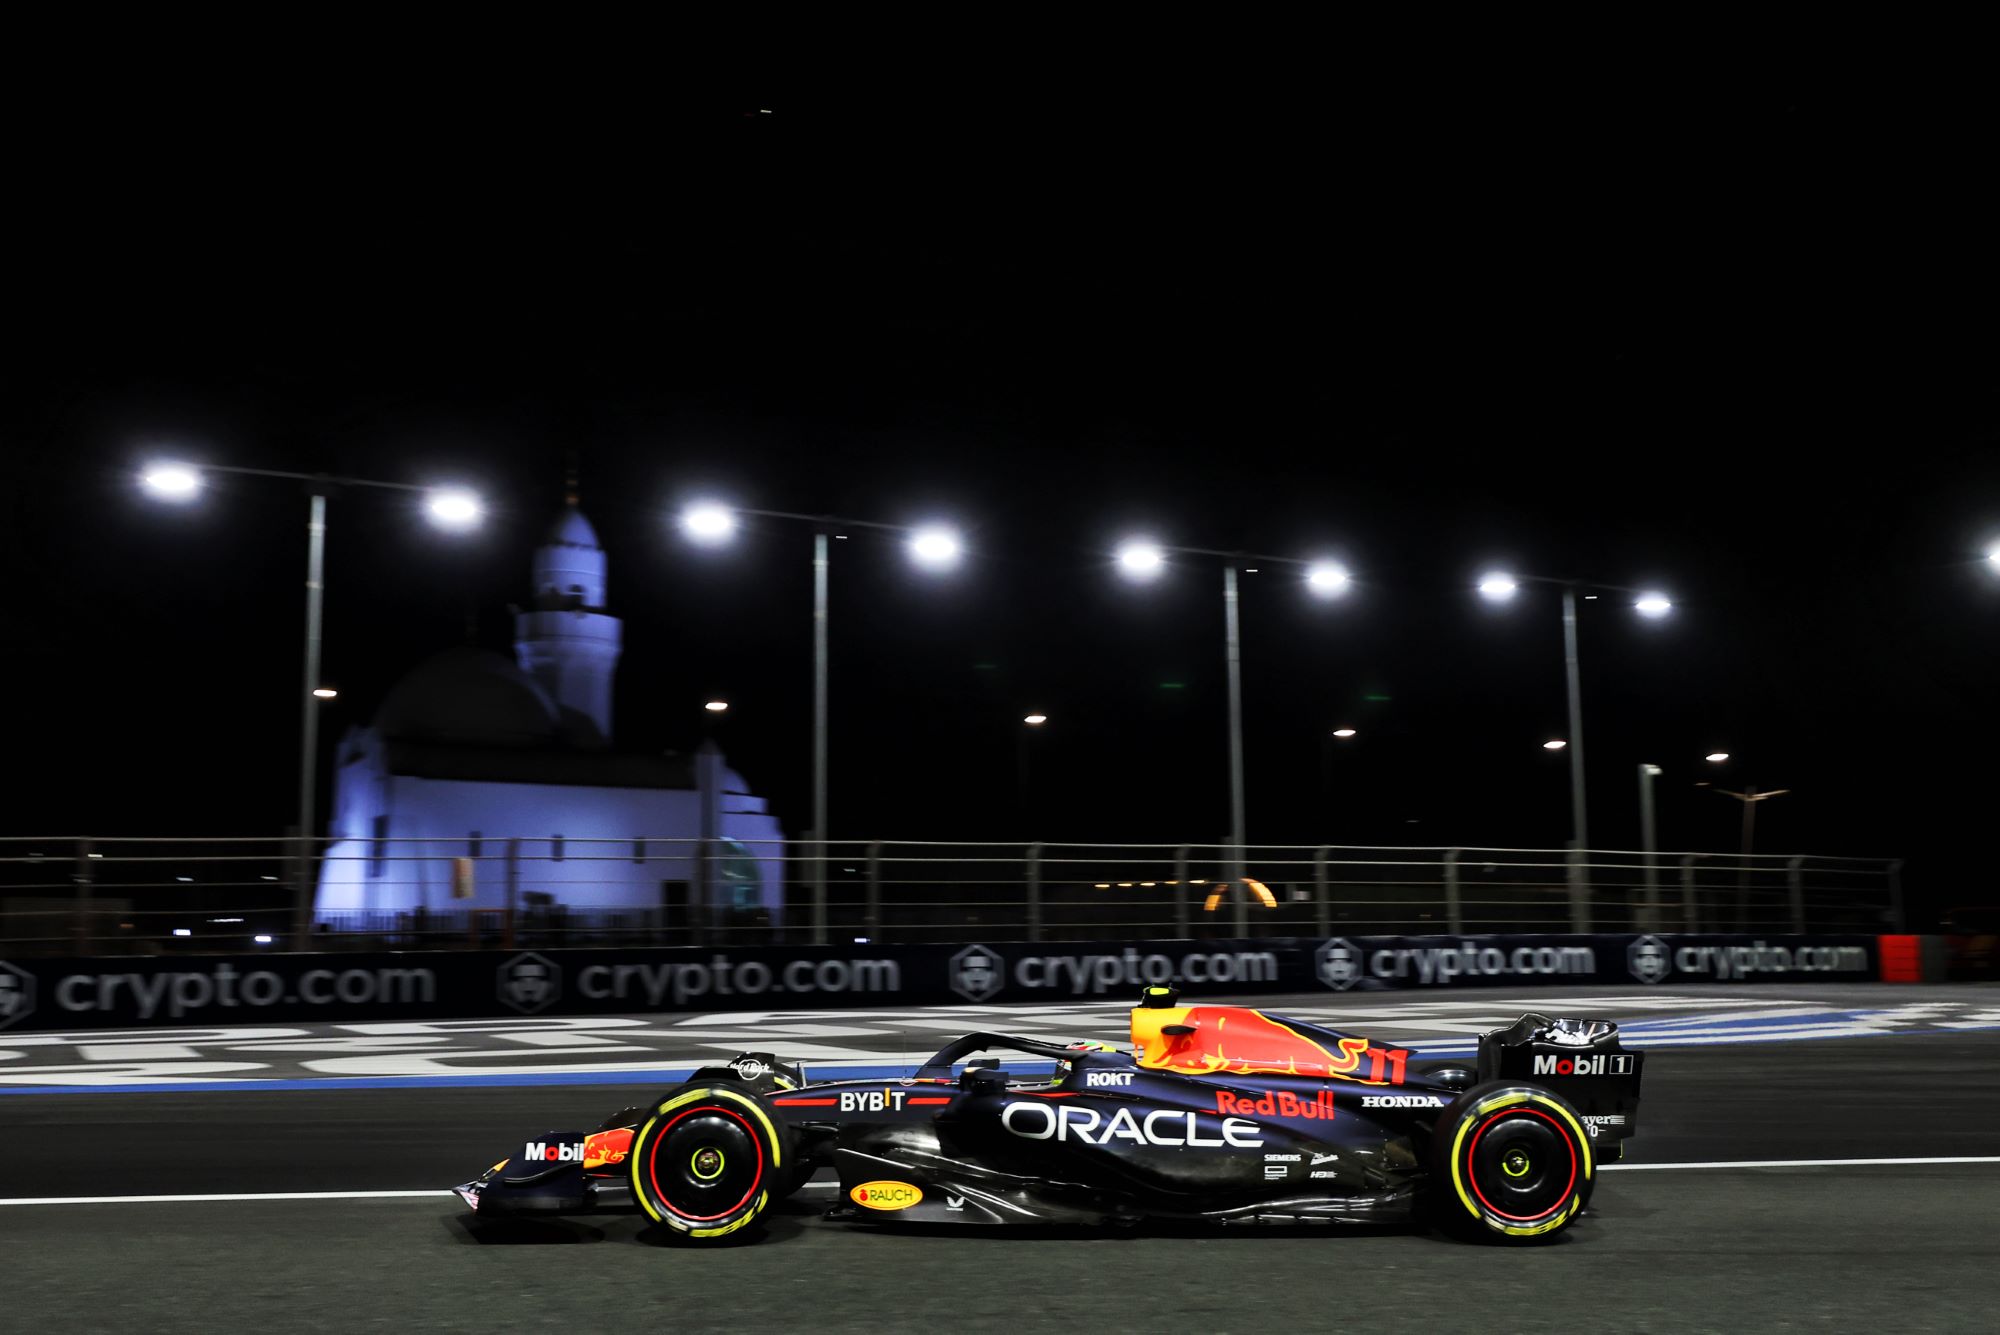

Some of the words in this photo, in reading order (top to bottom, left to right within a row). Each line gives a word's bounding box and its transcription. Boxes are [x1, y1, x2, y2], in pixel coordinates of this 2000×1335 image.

[1015, 948, 1278, 994] crypto.com
[1370, 941, 1595, 984] crypto.com
[1675, 940, 1868, 979] crypto.com
[56, 962, 435, 1019] crypto.com
[577, 955, 902, 1004] crypto.com
[1087, 1072, 1135, 1087] ROKT
[1366, 1048, 1408, 1084] 11
[1533, 1055, 1606, 1075] Mobil
[840, 1087, 905, 1111] BYBIT
[1215, 1091, 1276, 1115] Red
[1277, 1091, 1335, 1120] Bull
[1361, 1096, 1444, 1108] HONDA
[1001, 1101, 1265, 1147] ORACLE
[525, 1142, 584, 1161] Mobil
[869, 1189, 913, 1201] RAUCH
